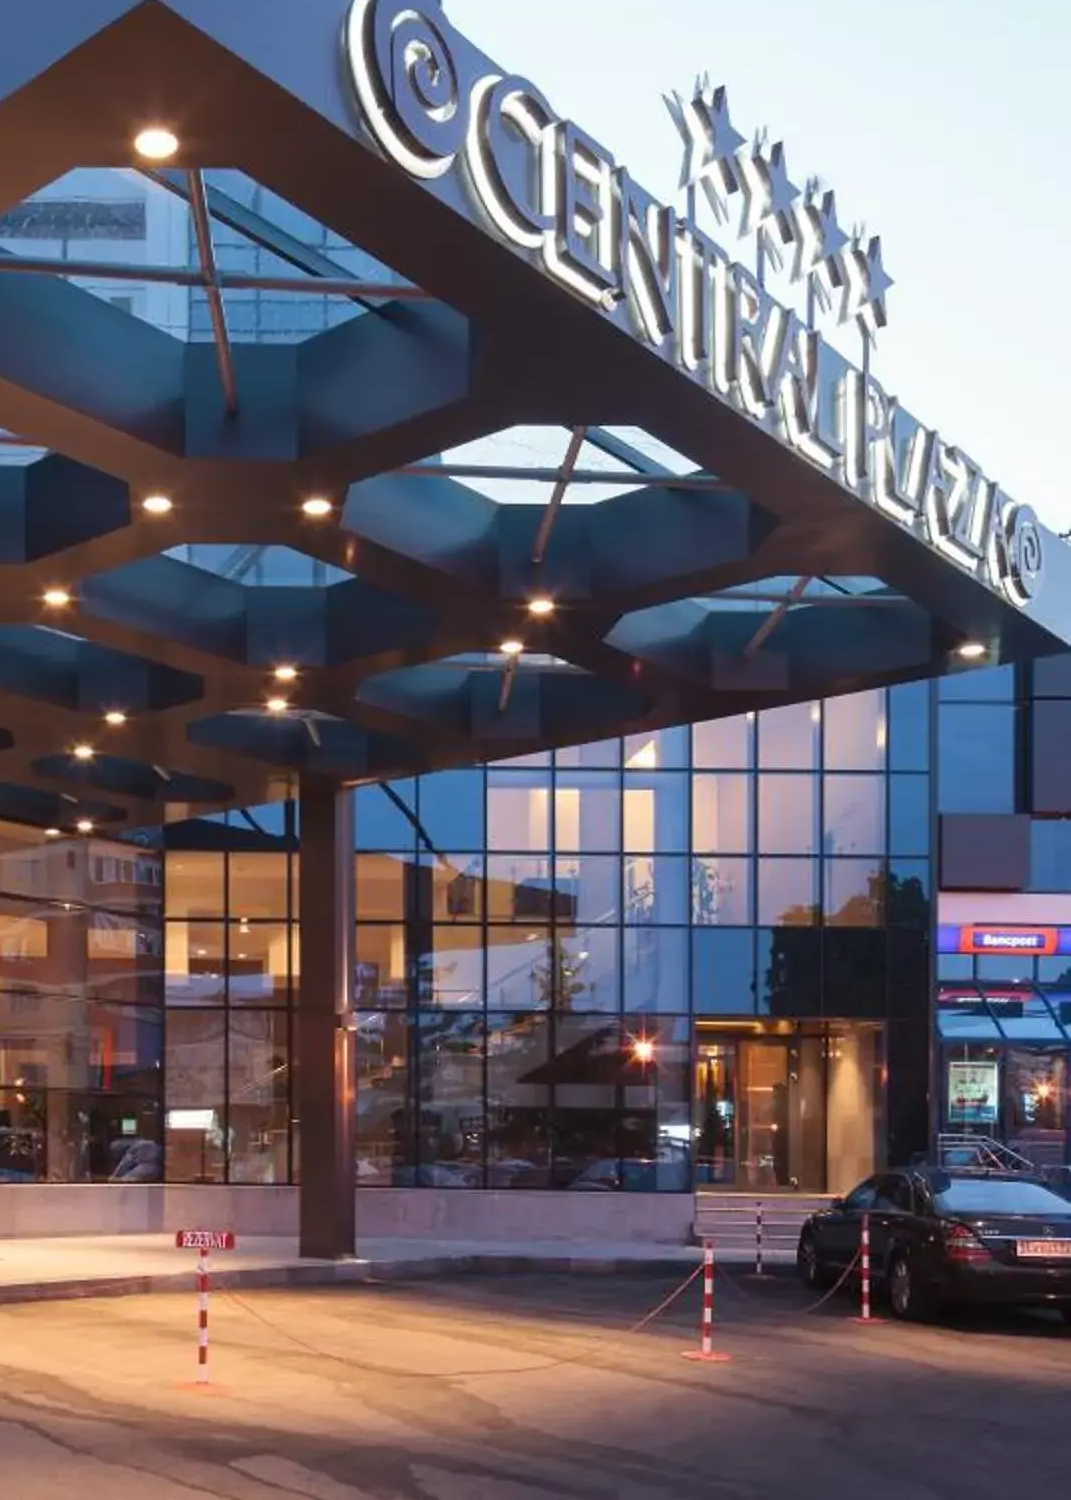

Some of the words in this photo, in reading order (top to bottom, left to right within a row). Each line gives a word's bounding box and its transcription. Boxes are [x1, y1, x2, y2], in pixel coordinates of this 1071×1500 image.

[466, 73, 845, 469] CENTRAL
[844, 367, 1017, 588] PLAZA
[982, 933, 1039, 947] Bancpost
